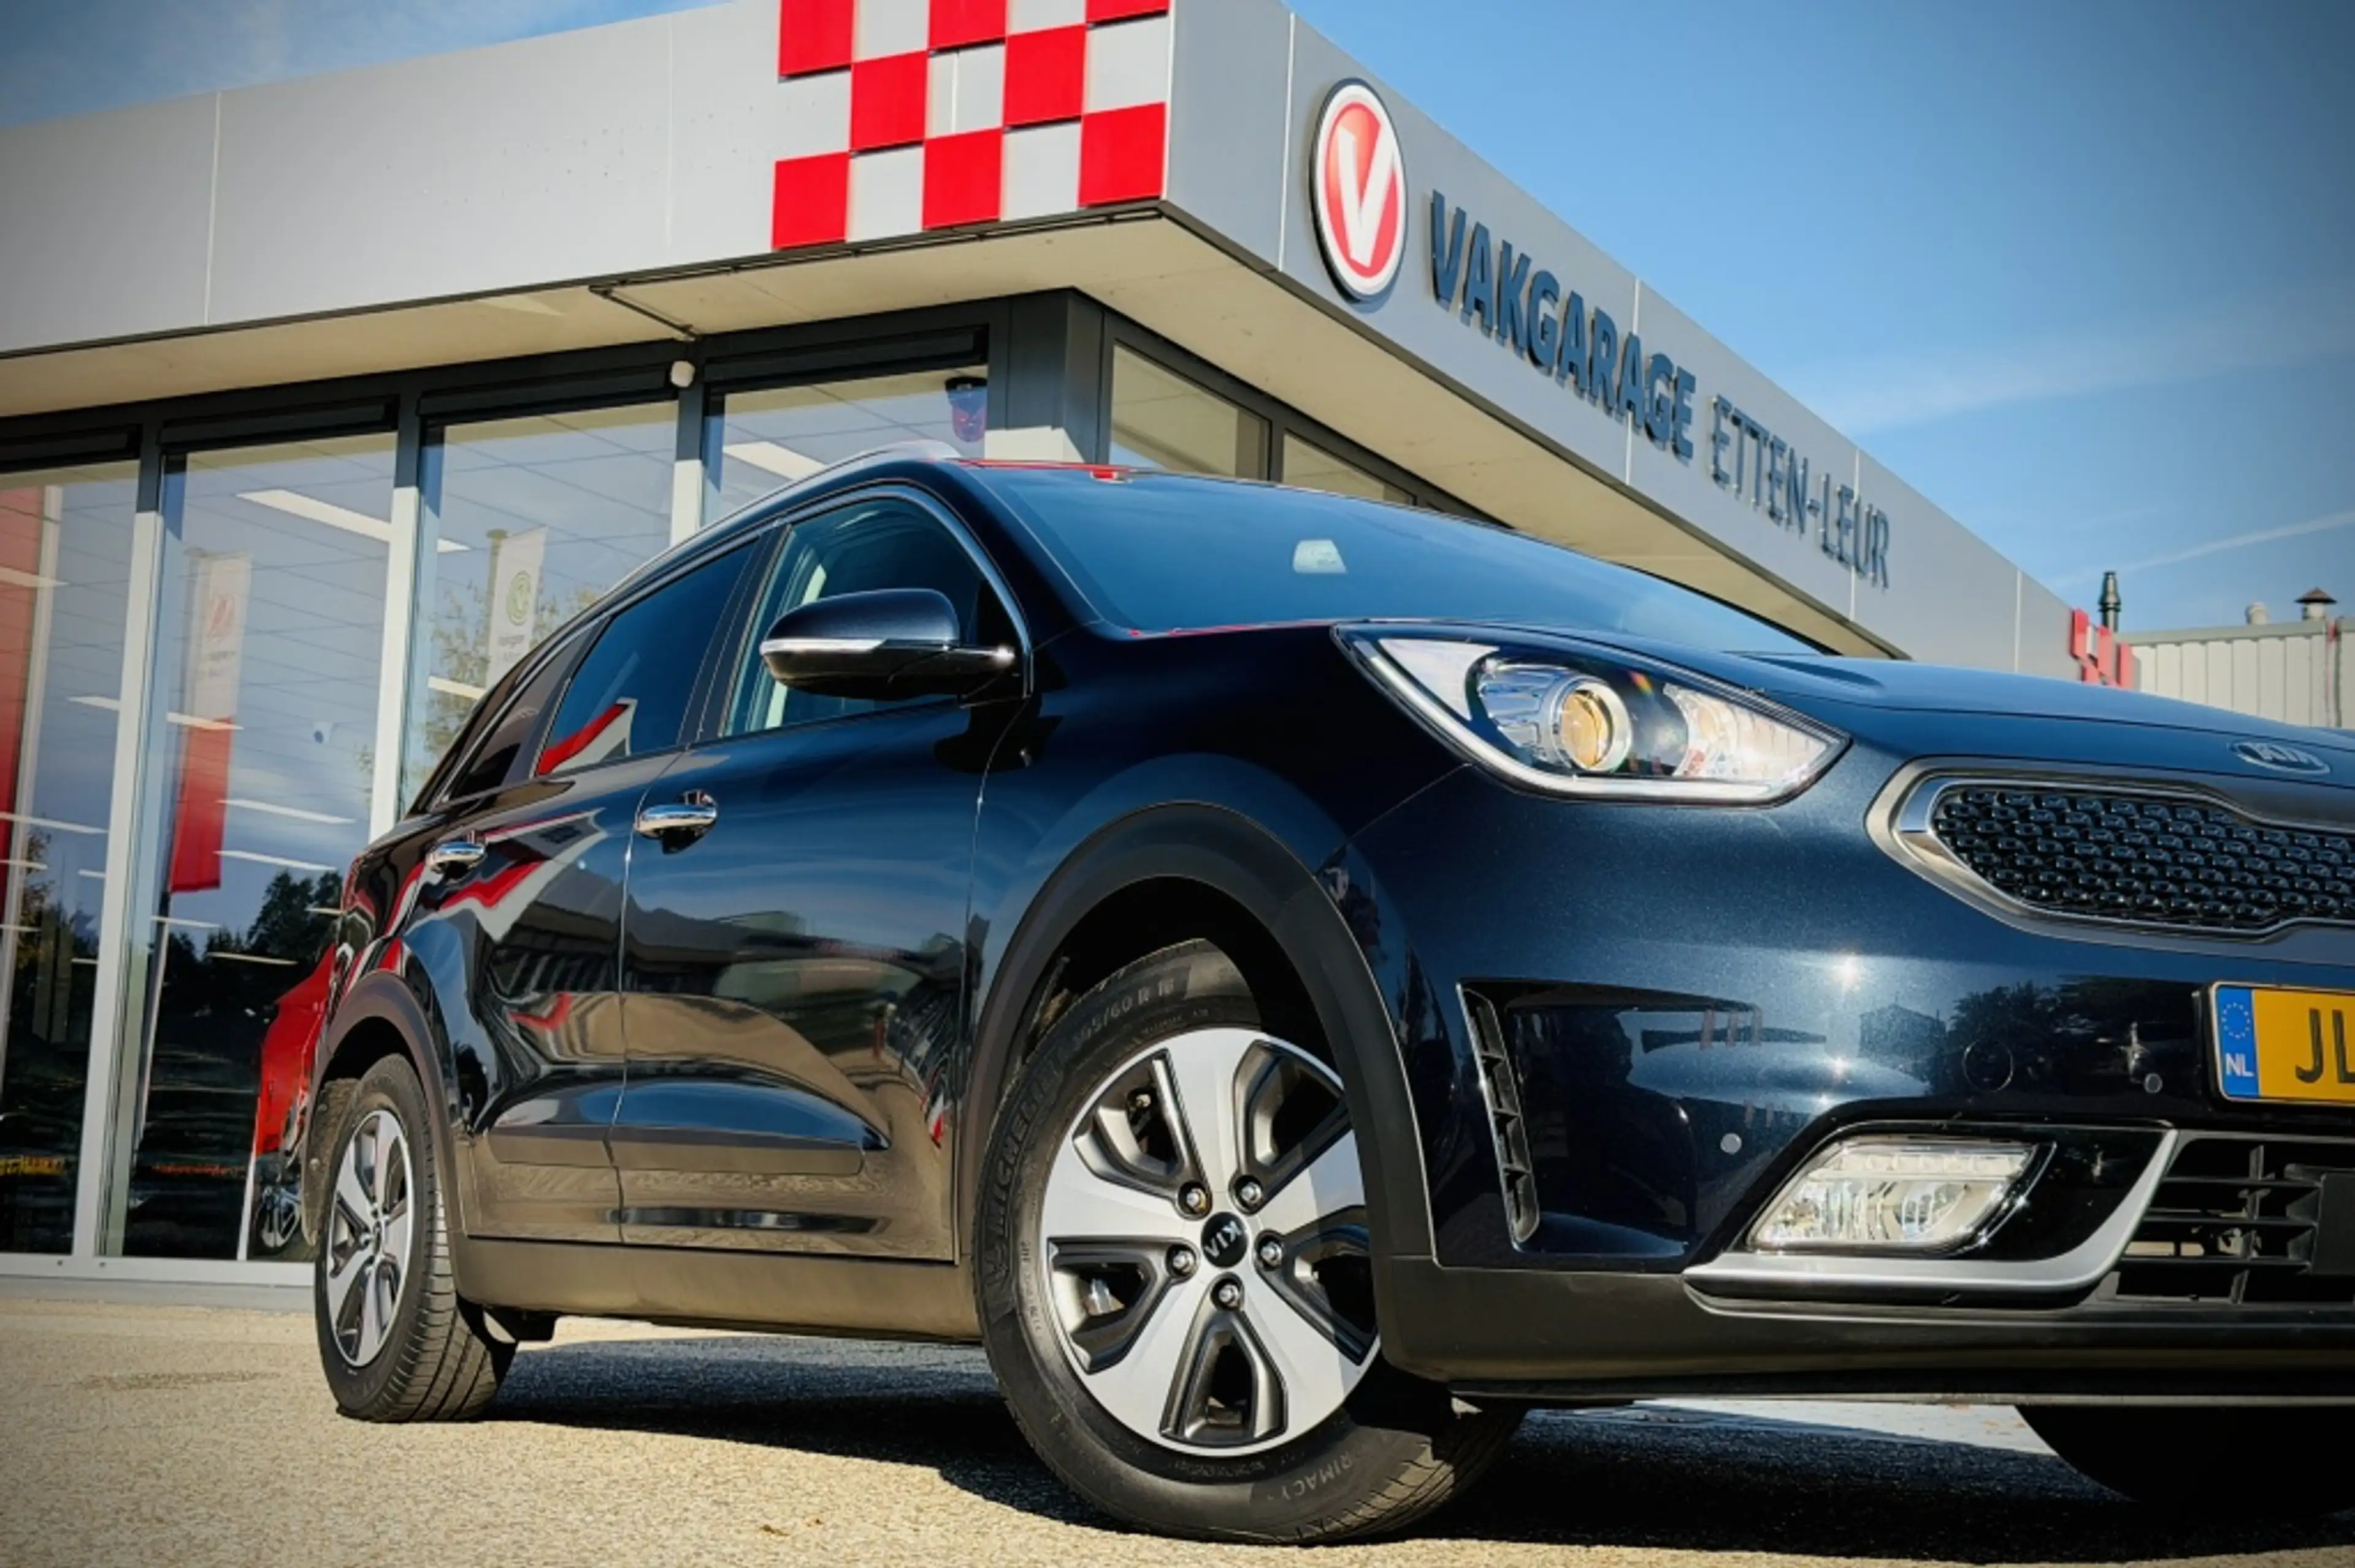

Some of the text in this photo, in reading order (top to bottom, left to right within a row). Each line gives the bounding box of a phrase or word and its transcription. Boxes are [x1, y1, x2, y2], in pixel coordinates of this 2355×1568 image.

[1335, 124, 1396, 268] V
[1431, 190, 1889, 589] VAKGARAGE ETTEN-LEUR
[2226, 1052, 2254, 1077] NL
[2295, 1008, 2355, 1084] JL
[1204, 1220, 1242, 1258] KIA
[1281, 1445, 1363, 1501] RIMACY
